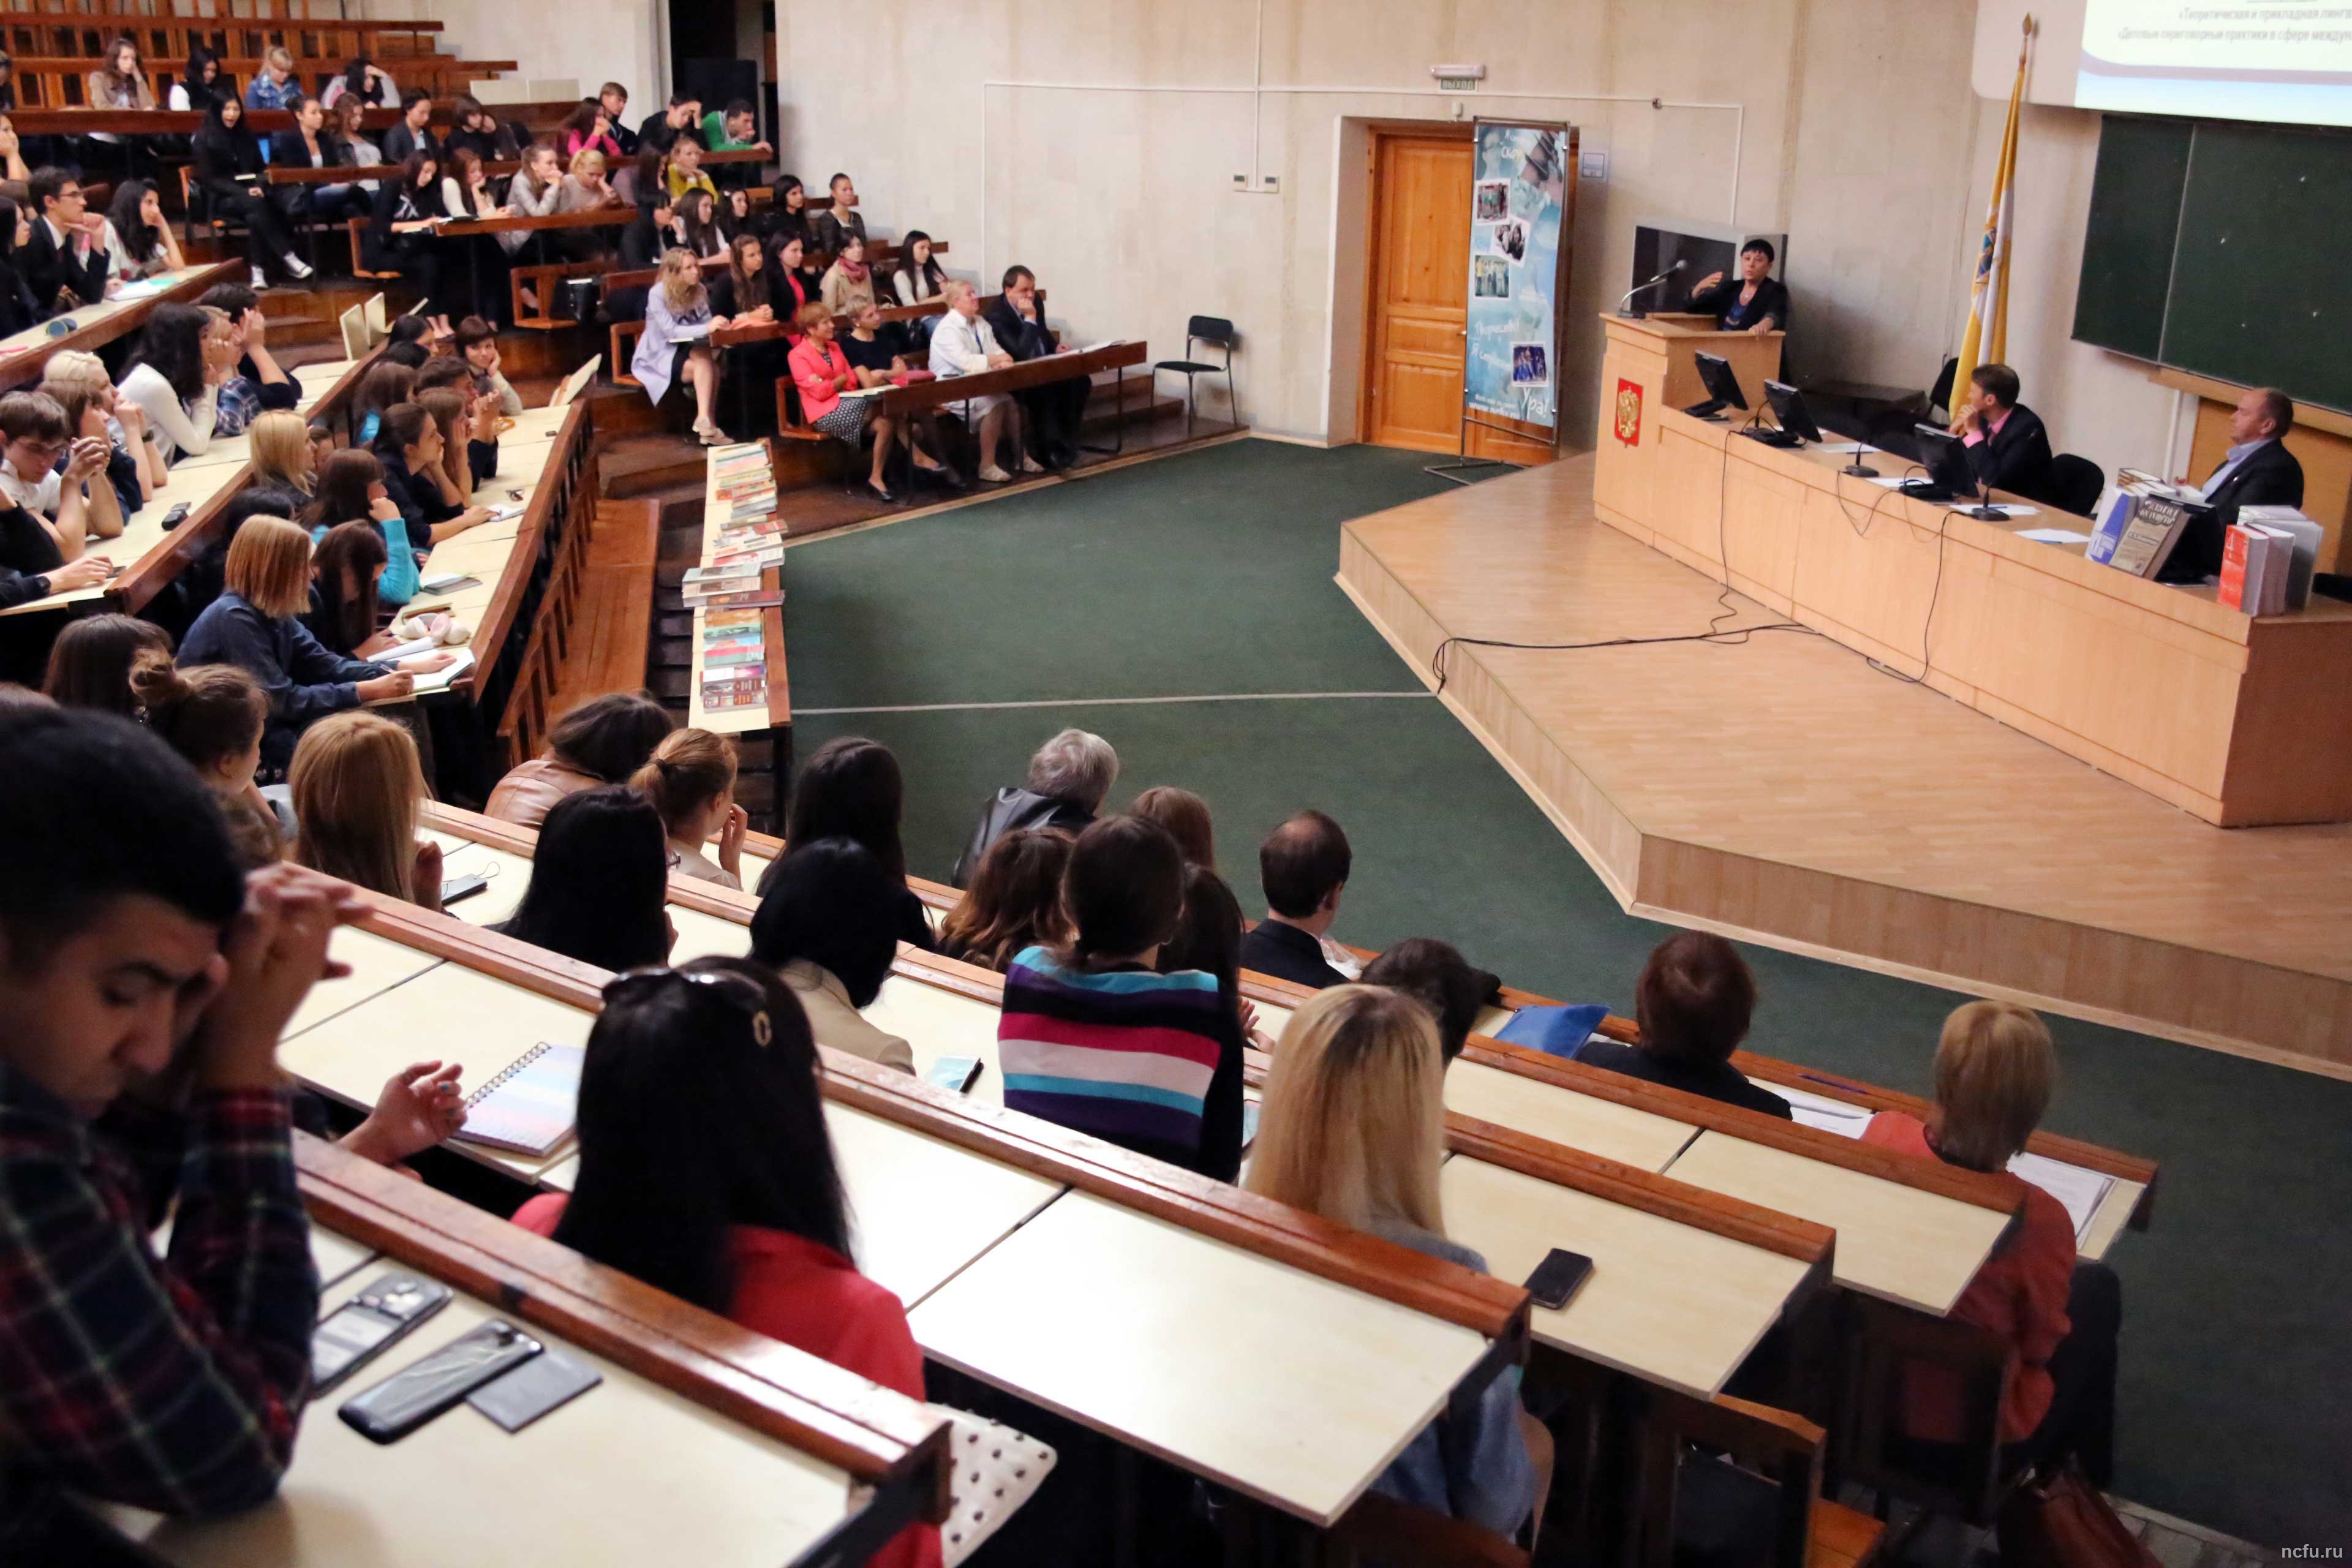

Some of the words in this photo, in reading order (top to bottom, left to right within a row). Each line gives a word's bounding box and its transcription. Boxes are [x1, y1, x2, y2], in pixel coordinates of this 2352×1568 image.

[2225, 30, 2268, 43] практики
[2278, 26, 2309, 44] сфере
[1441, 80, 1474, 89] ВЫХОД
